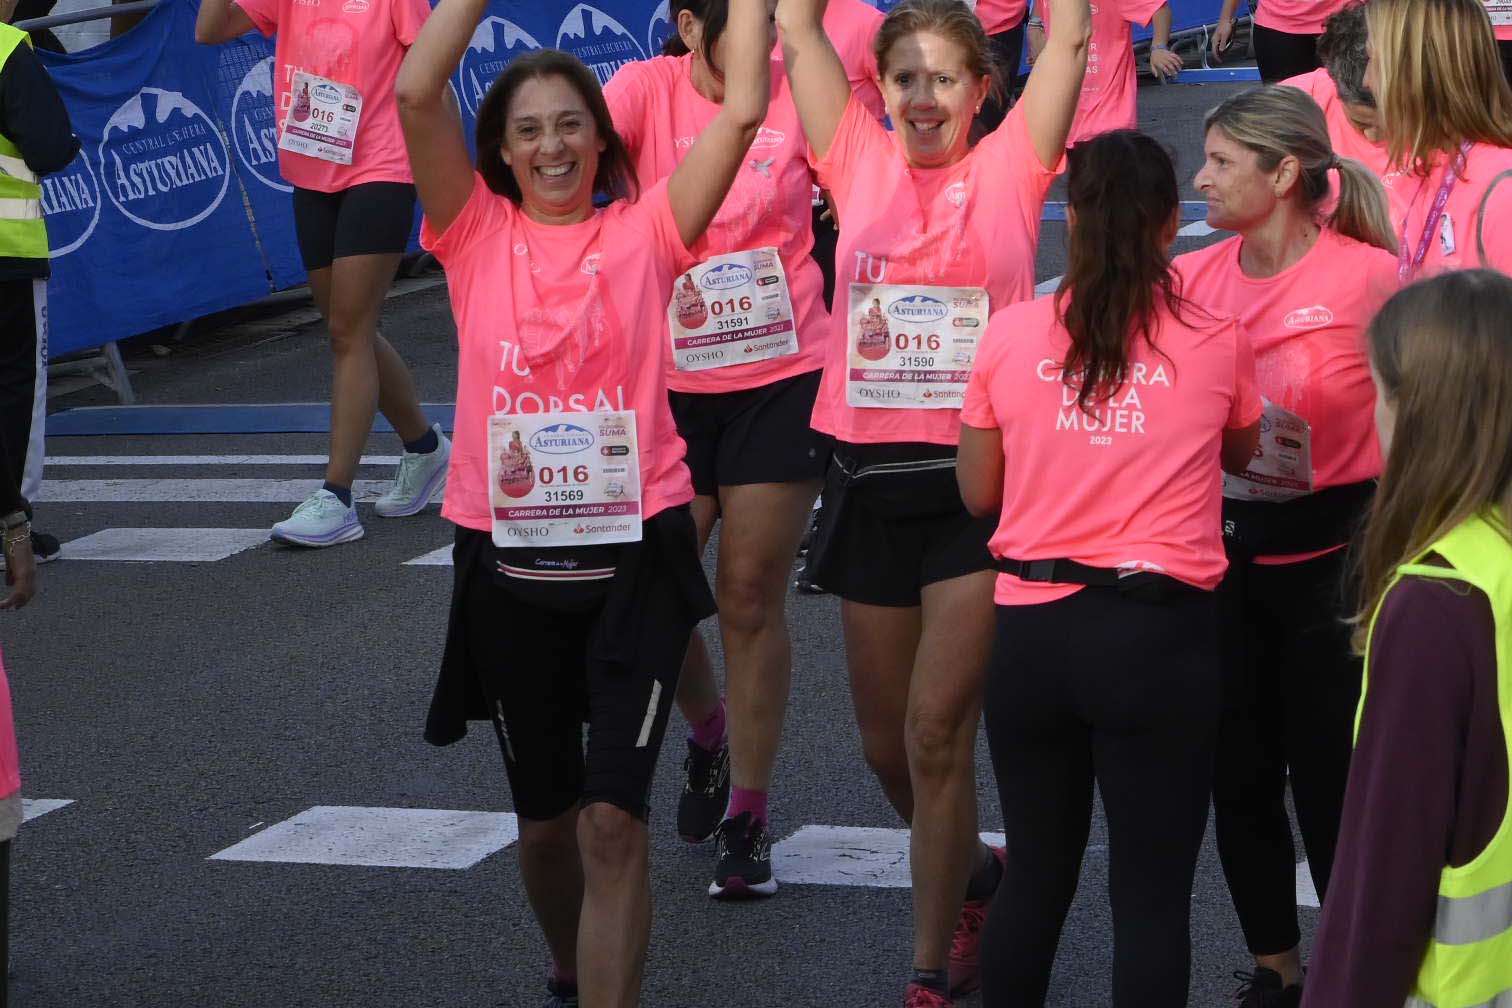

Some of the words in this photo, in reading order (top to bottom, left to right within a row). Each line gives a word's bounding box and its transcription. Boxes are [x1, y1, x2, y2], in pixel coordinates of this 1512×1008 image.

[311, 107, 335, 123] 016
[110, 142, 224, 204] ASTURIANA
[852, 250, 888, 284] TU
[705, 271, 750, 287] ASTURIANA
[710, 295, 753, 316] 016
[893, 305, 944, 316] ASTURIANA
[716, 316, 750, 330] 31591
[687, 336, 721, 346] CARRERA
[722, 333, 732, 341] DE
[733, 331, 743, 339] LA
[743, 328, 768, 338] MUJER
[894, 333, 941, 351] 016
[753, 339, 789, 352] Santander
[499, 340, 531, 377] TU
[686, 350, 724, 363] OYSHO
[899, 356, 935, 367] 31590
[862, 372, 901, 380] CARRERA
[901, 372, 913, 380] DE
[914, 372, 925, 380] LA
[926, 373, 952, 381] MUJER
[858, 387, 901, 399] OYSHO
[1055, 408, 1146, 434] MUJER
[599, 428, 627, 437] SUMA
[534, 436, 590, 449] ASTURIANA
[538, 464, 590, 485] 016
[544, 489, 584, 503] 31569
[508, 508, 547, 518] CARRERA
[549, 508, 562, 516] DE
[562, 507, 574, 515] LA
[575, 506, 605, 514] MUJER
[607, 505, 627, 513] 2023
[506, 526, 550, 538] OYSHO
[585, 522, 632, 534] Santander
